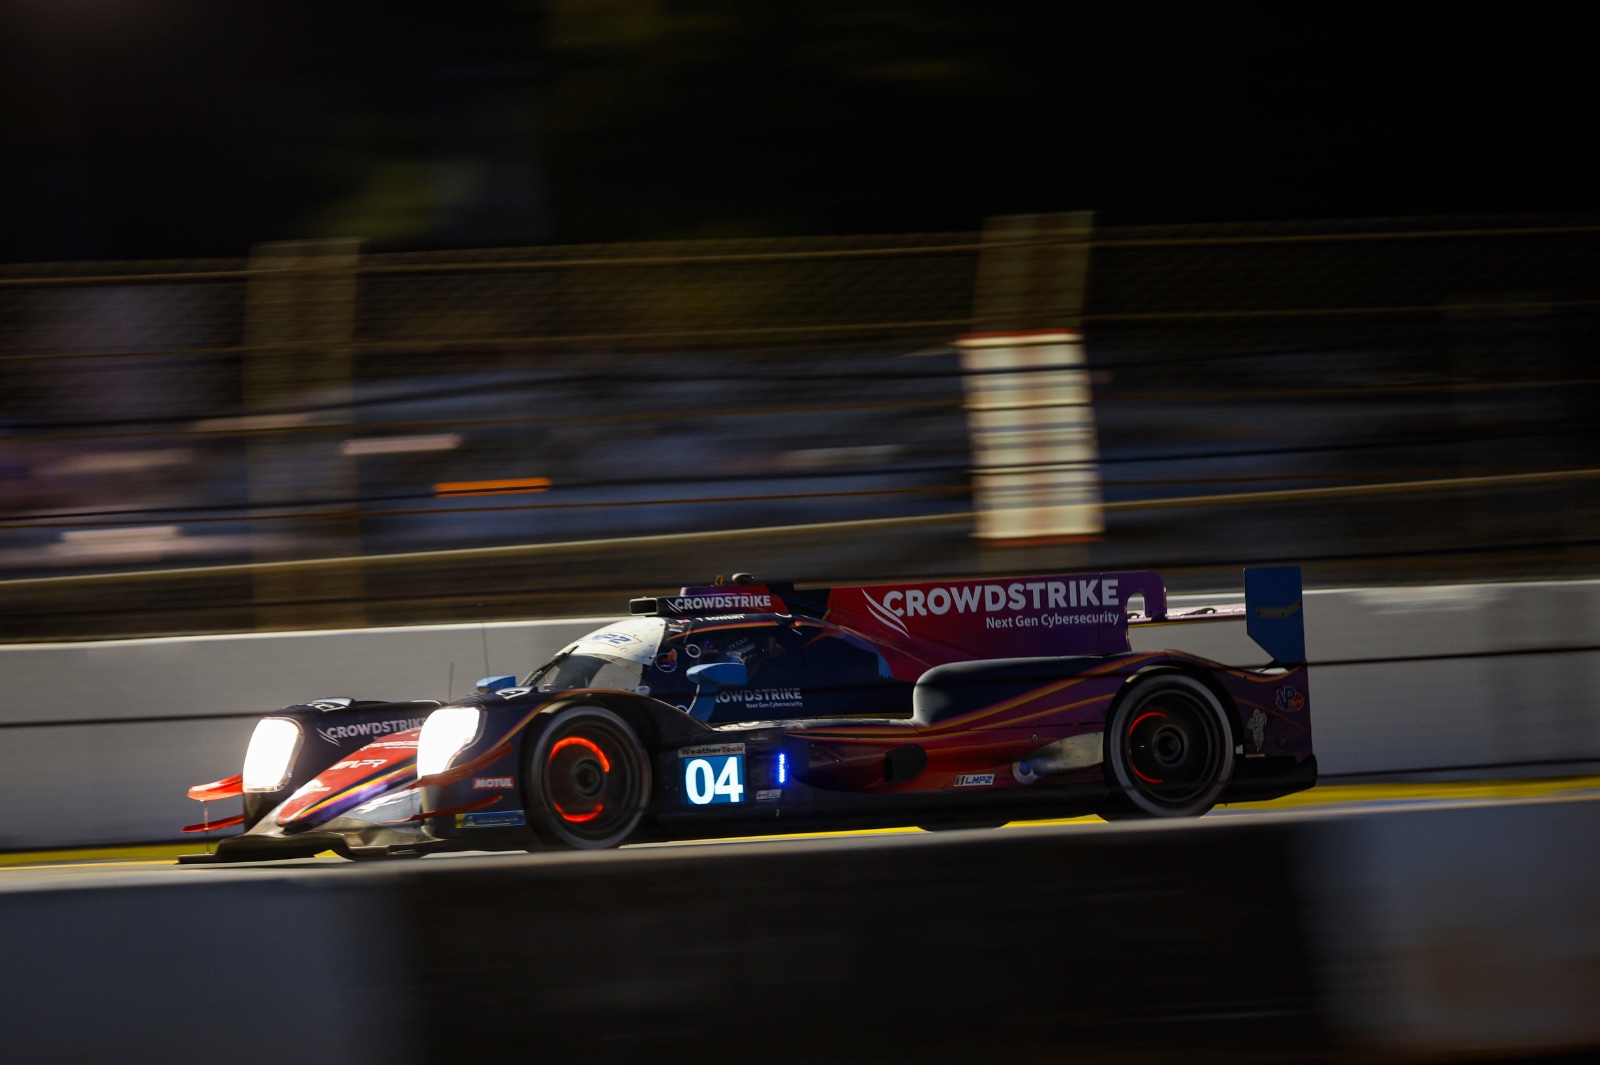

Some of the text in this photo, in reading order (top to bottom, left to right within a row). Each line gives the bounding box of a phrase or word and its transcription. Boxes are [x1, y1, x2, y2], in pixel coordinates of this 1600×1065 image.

[674, 594, 771, 611] CROWDSTRIKE
[883, 578, 1119, 617] CROWDSTRIKE
[986, 611, 1119, 629] Next Gen Cybersecurity
[715, 687, 802, 704] OWDSTRIKE
[770, 701, 803, 709] Cybersecurity
[682, 745, 743, 755] WeatherTech
[475, 777, 513, 788] MOTUL
[685, 756, 744, 805] 04
[965, 775, 993, 784] LMP2
